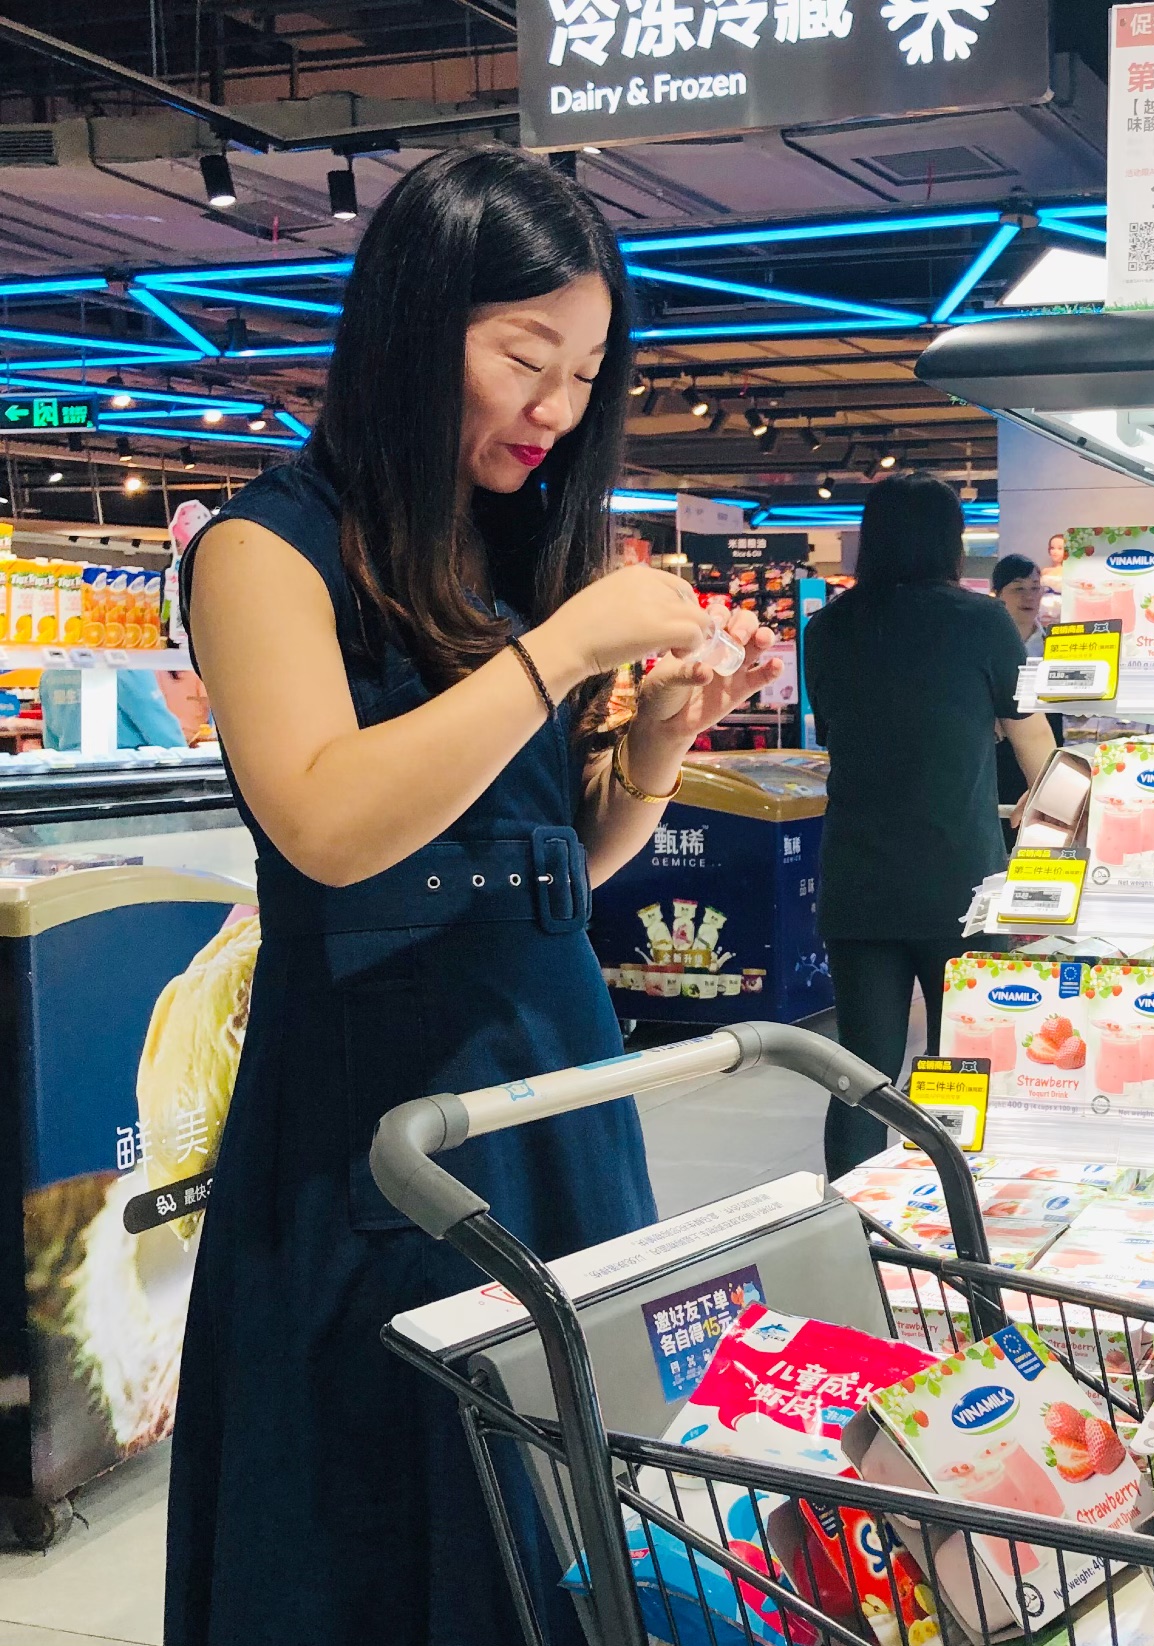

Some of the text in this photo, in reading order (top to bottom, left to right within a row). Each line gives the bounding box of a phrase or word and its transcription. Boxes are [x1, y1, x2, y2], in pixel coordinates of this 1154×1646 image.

[548, 0, 853, 66] 冷冻冷藏
[550, 70, 747, 115] Dairy & Frozen
[651, 856, 706, 868] GEMICE
[991, 991, 1040, 1002] VINAMILK
[916, 1080, 966, 1092] 第二件半价
[1017, 1074, 1080, 1091] Strawberry
[1007, 1101, 1022, 1109] 400
[1024, 1103, 1029, 1111] g
[1028, 1090, 1068, 1099] Yogurt Drink
[653, 1289, 730, 1334] 邀好友下单
[660, 1312, 733, 1357] 各自得15元
[766, 1360, 885, 1405] 儿童成长
[953, 1389, 1015, 1425] VINAMILK
[1076, 1479, 1142, 1524] Strawberry
[1120, 1505, 1142, 1524] Drink
[1067, 1567, 1096, 1590] weight:
